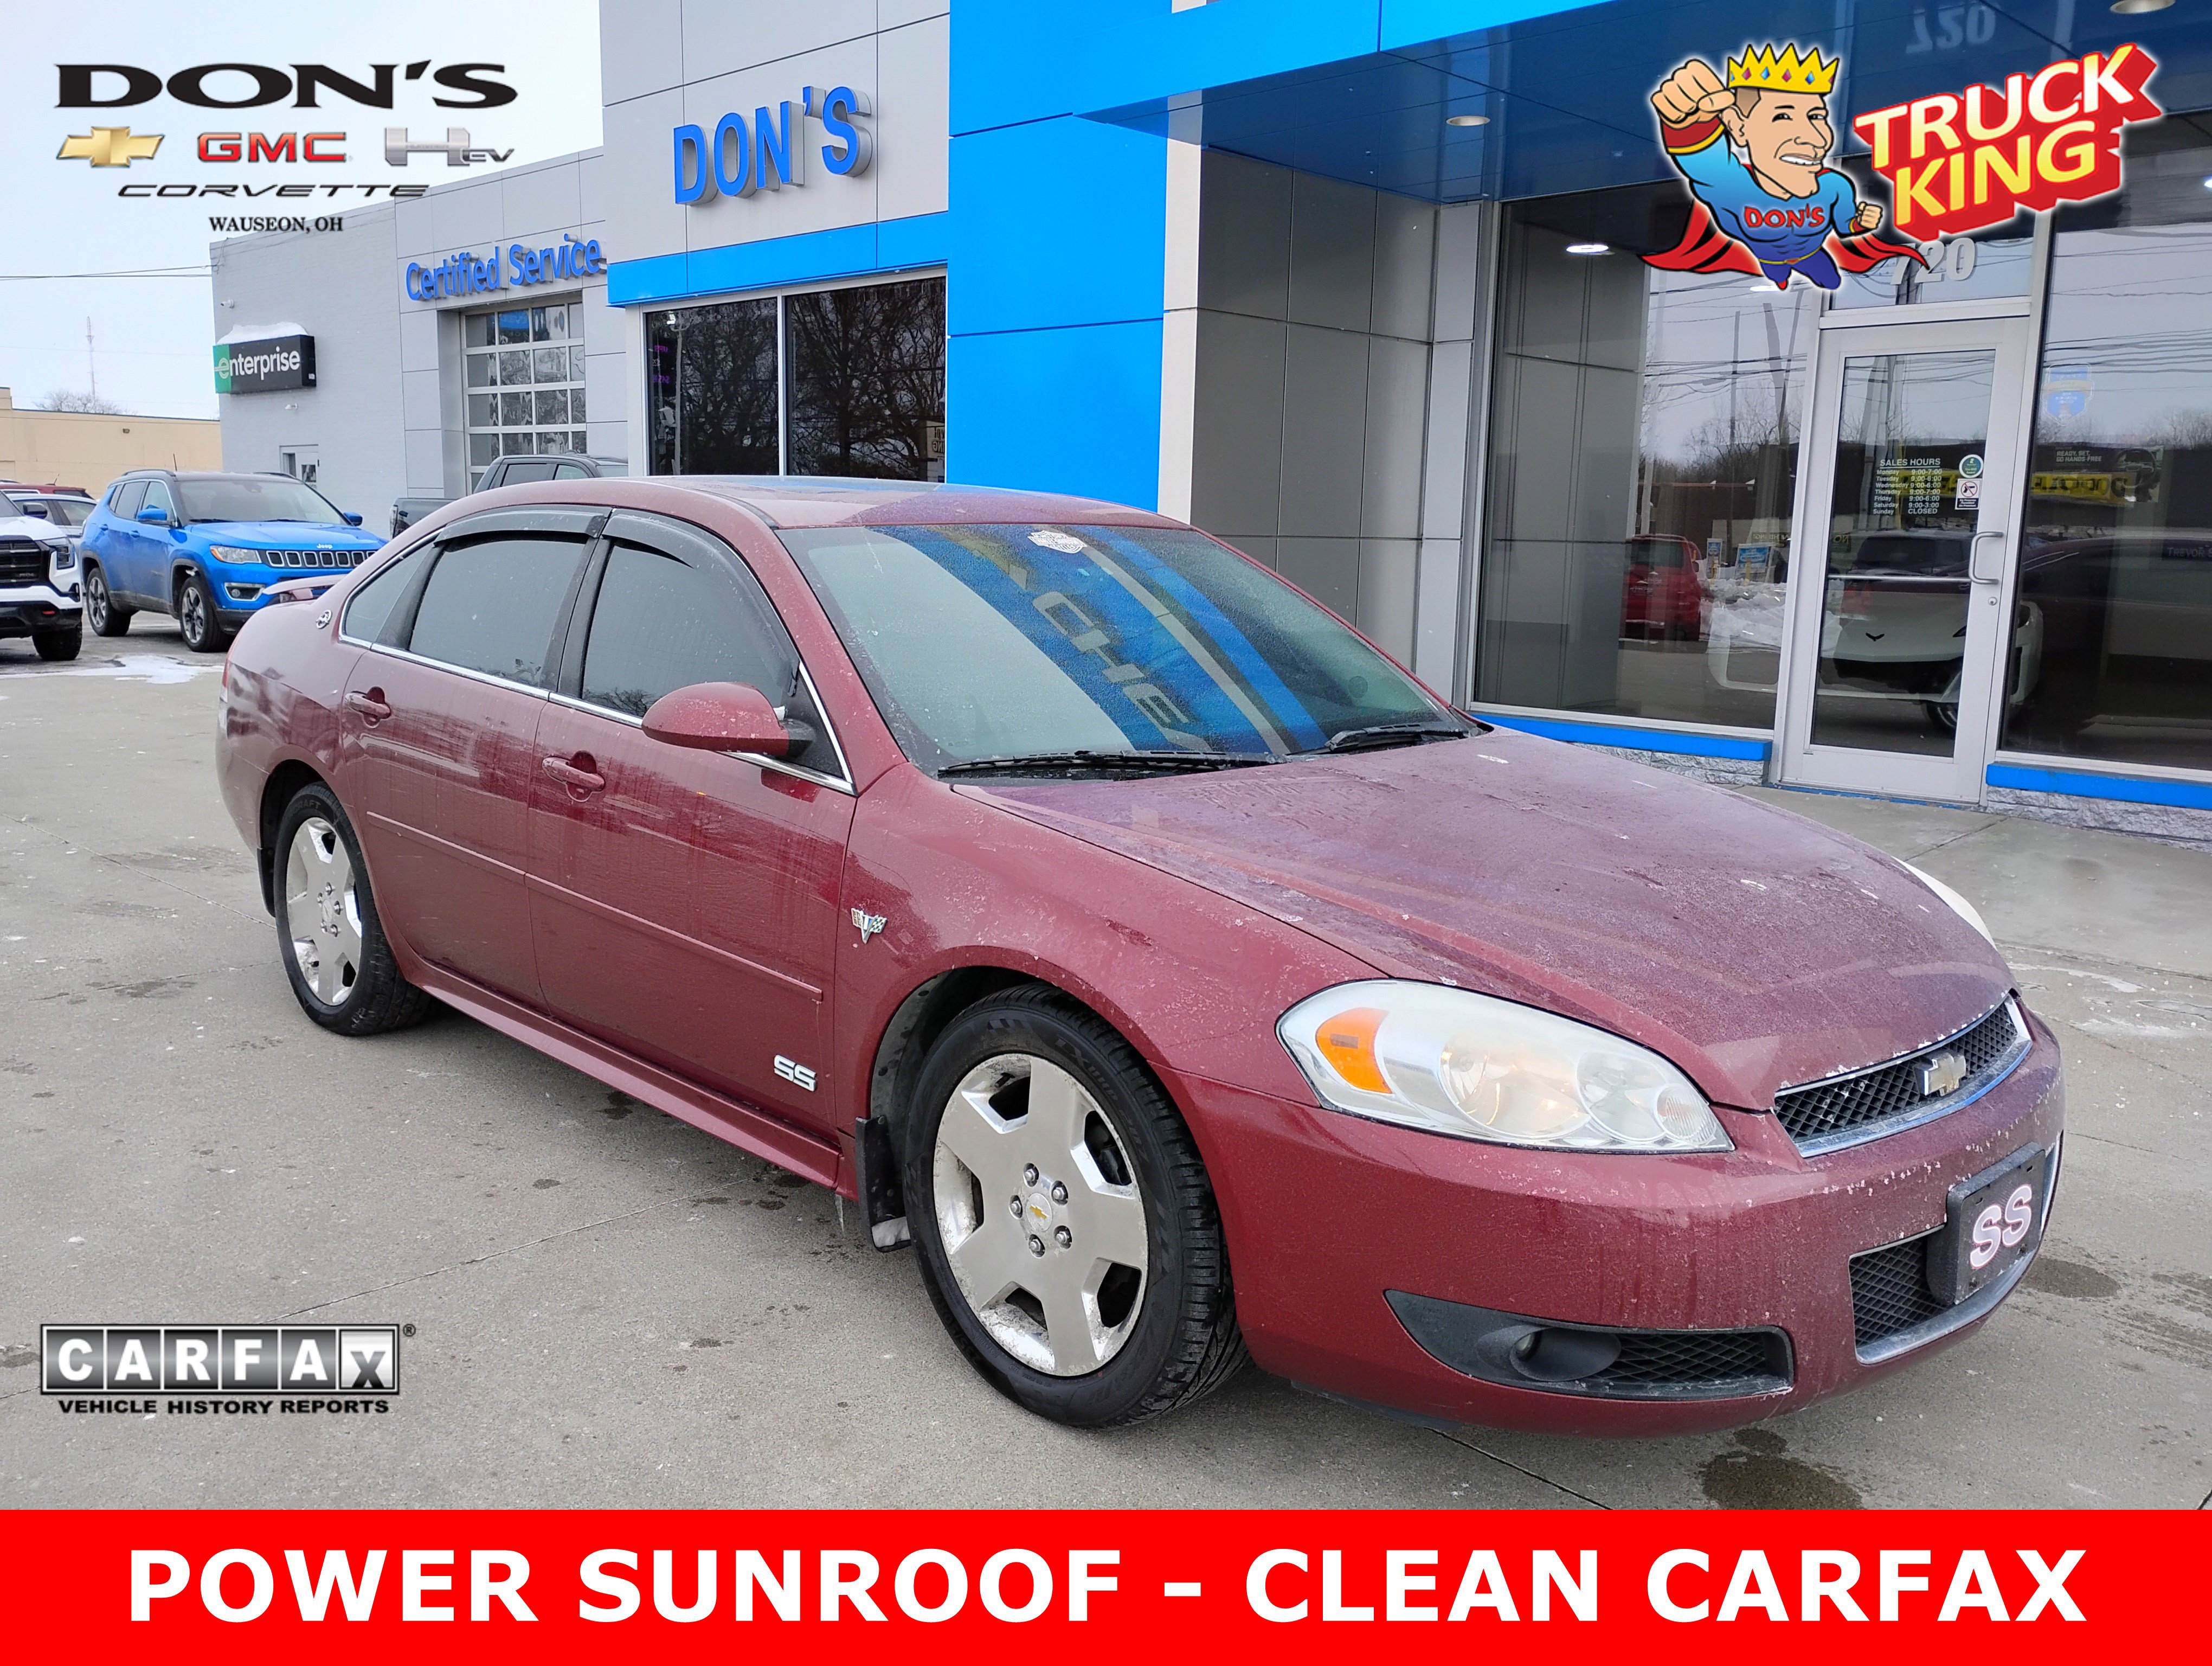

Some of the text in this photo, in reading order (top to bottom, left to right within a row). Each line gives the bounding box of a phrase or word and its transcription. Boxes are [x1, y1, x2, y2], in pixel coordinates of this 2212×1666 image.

[673, 85, 870, 205] DON'S
[406, 233, 601, 301] Certified Service
[215, 345, 301, 381] enterprise
[1880, 458, 1941, 467] SALES HOURS
[774, 1054, 818, 1092] SS
[1970, 1183, 2033, 1270] SS
